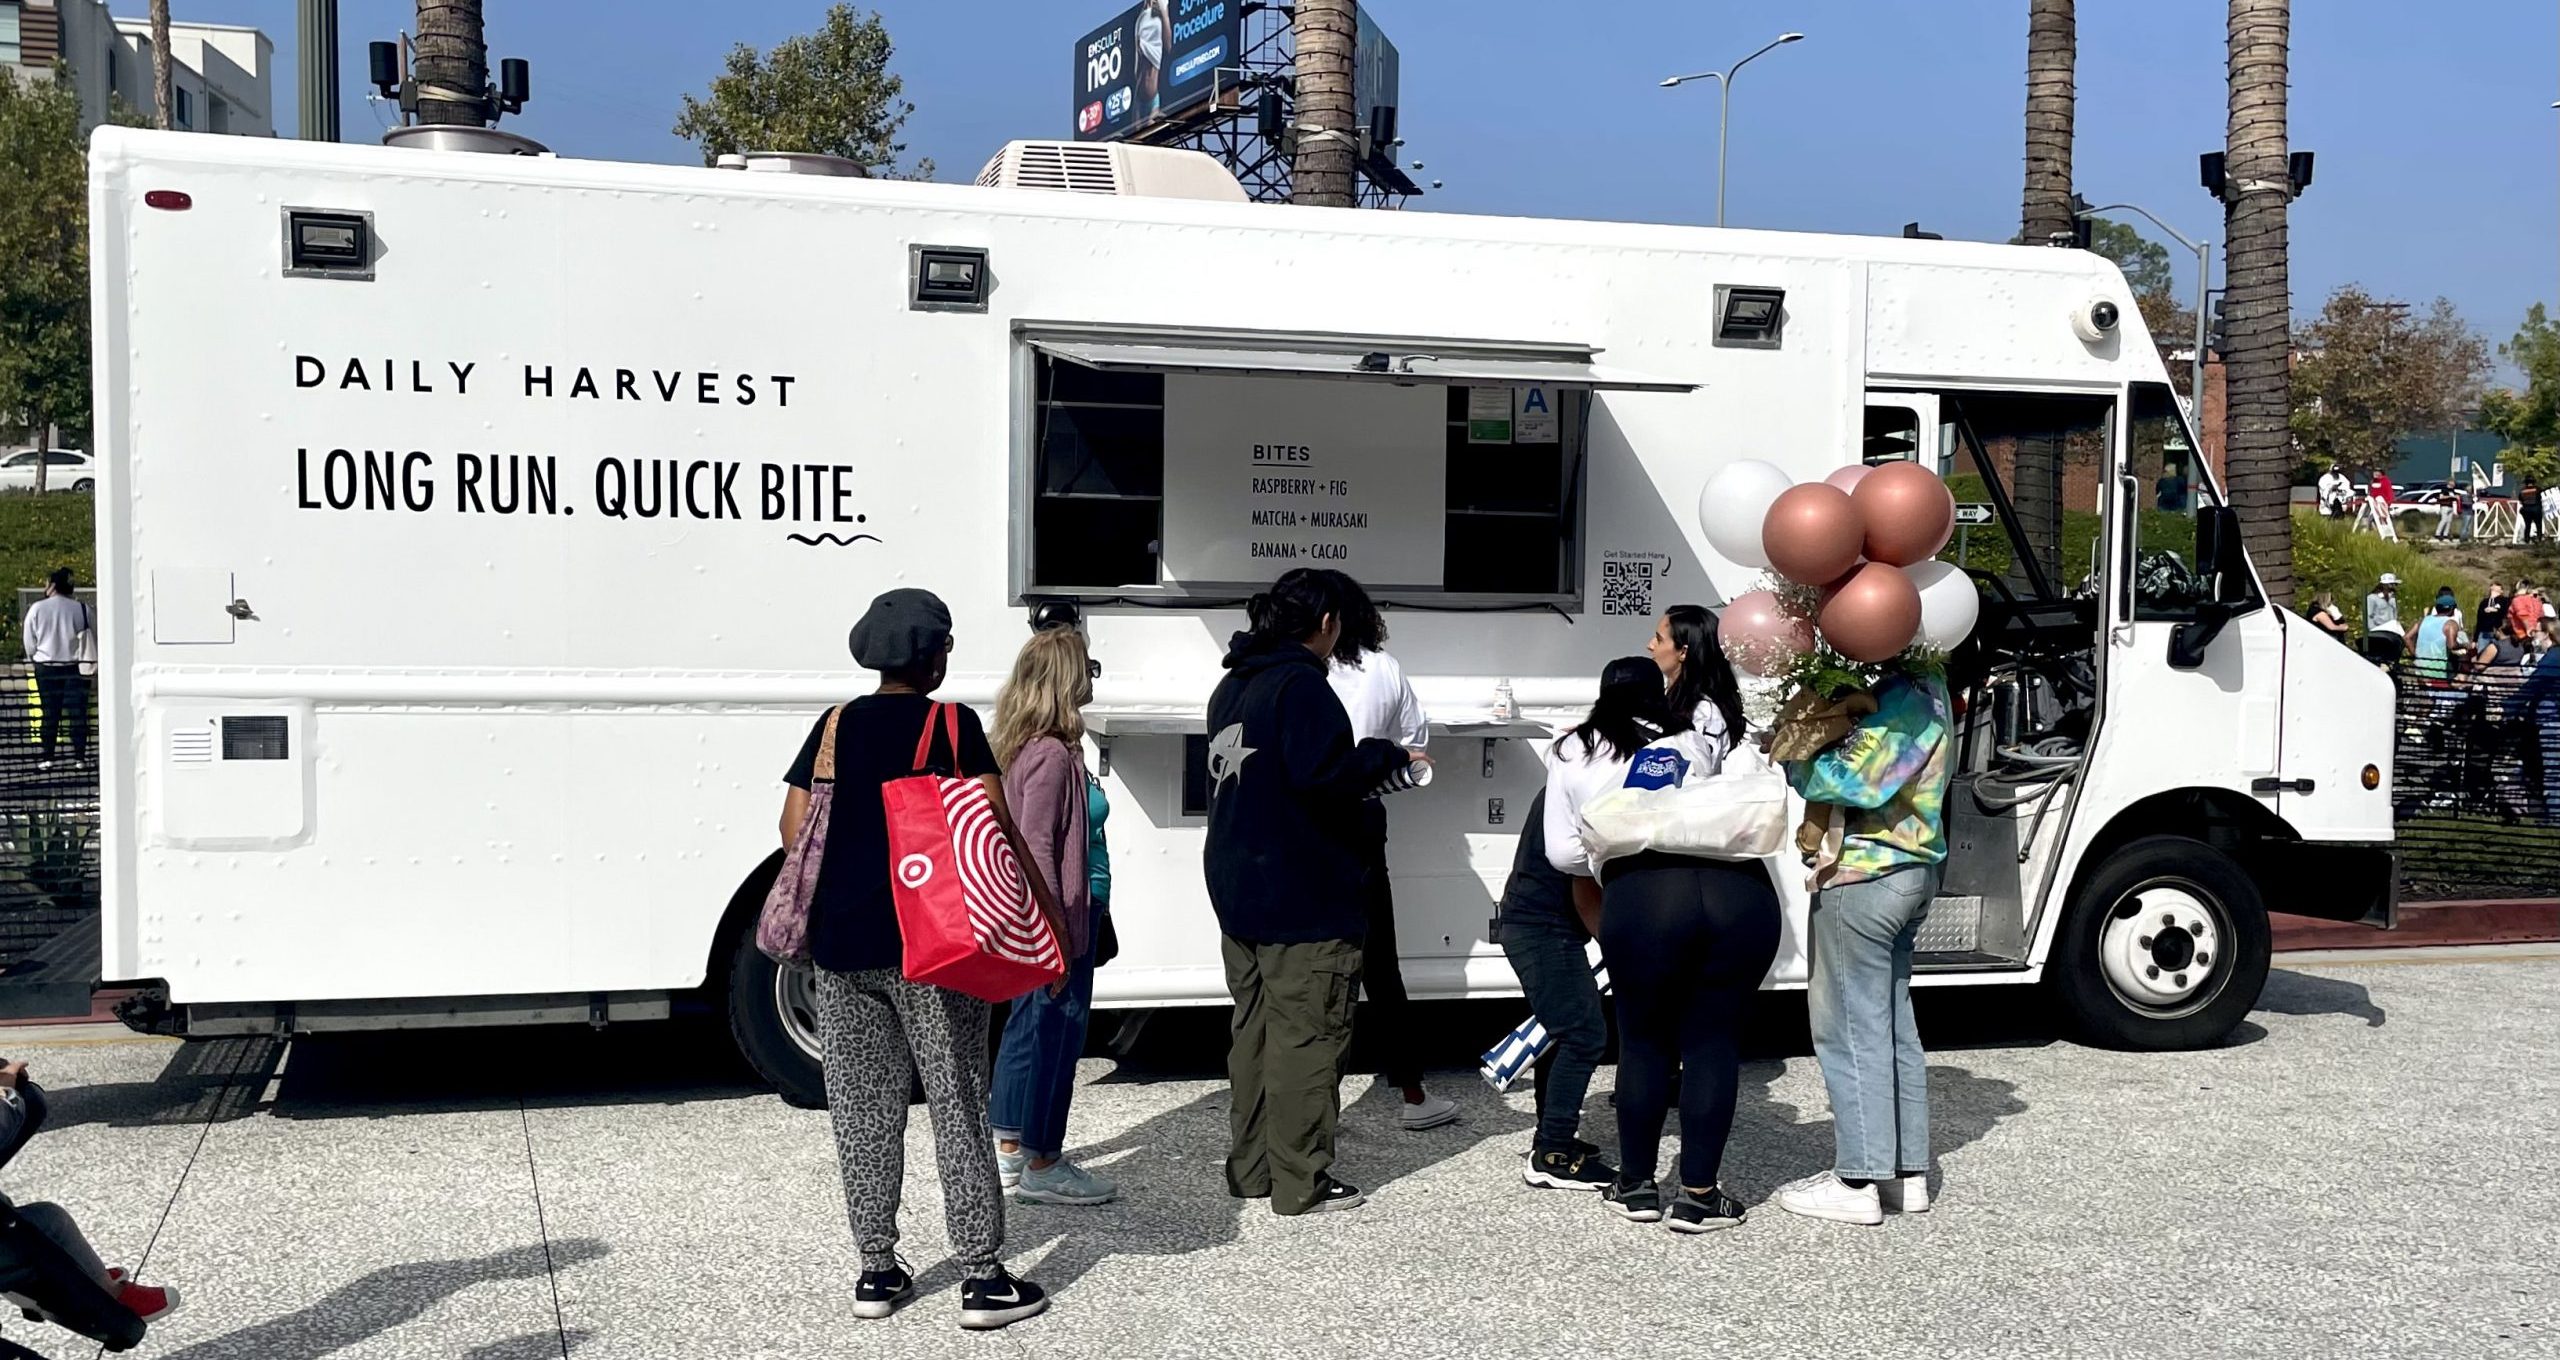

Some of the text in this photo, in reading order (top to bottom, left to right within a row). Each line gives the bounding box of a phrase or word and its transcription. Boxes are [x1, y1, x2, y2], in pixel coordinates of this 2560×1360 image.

[1173, 2, 1225, 44] Procedure
[1088, 27, 1122, 58] EMSCULPT
[1087, 46, 1122, 92] neo
[296, 355, 795, 407] DAILY HARVEST
[1523, 388, 1549, 413] A
[1253, 444, 1310, 461] BITES
[297, 448, 867, 523] LONG RUN. QUICK BITE.
[1252, 478, 1315, 495] RASPBERRY
[1330, 480, 1348, 496] FIG
[1252, 510, 1297, 526] MATCHA
[1311, 512, 1368, 528] MURASAKI
[1962, 510, 1978, 518] WAY
[1251, 542, 1297, 558] BANANA
[1311, 544, 1347, 559] CACAO
[1604, 550, 1618, 559] Get
[1619, 550, 1646, 559] Started
